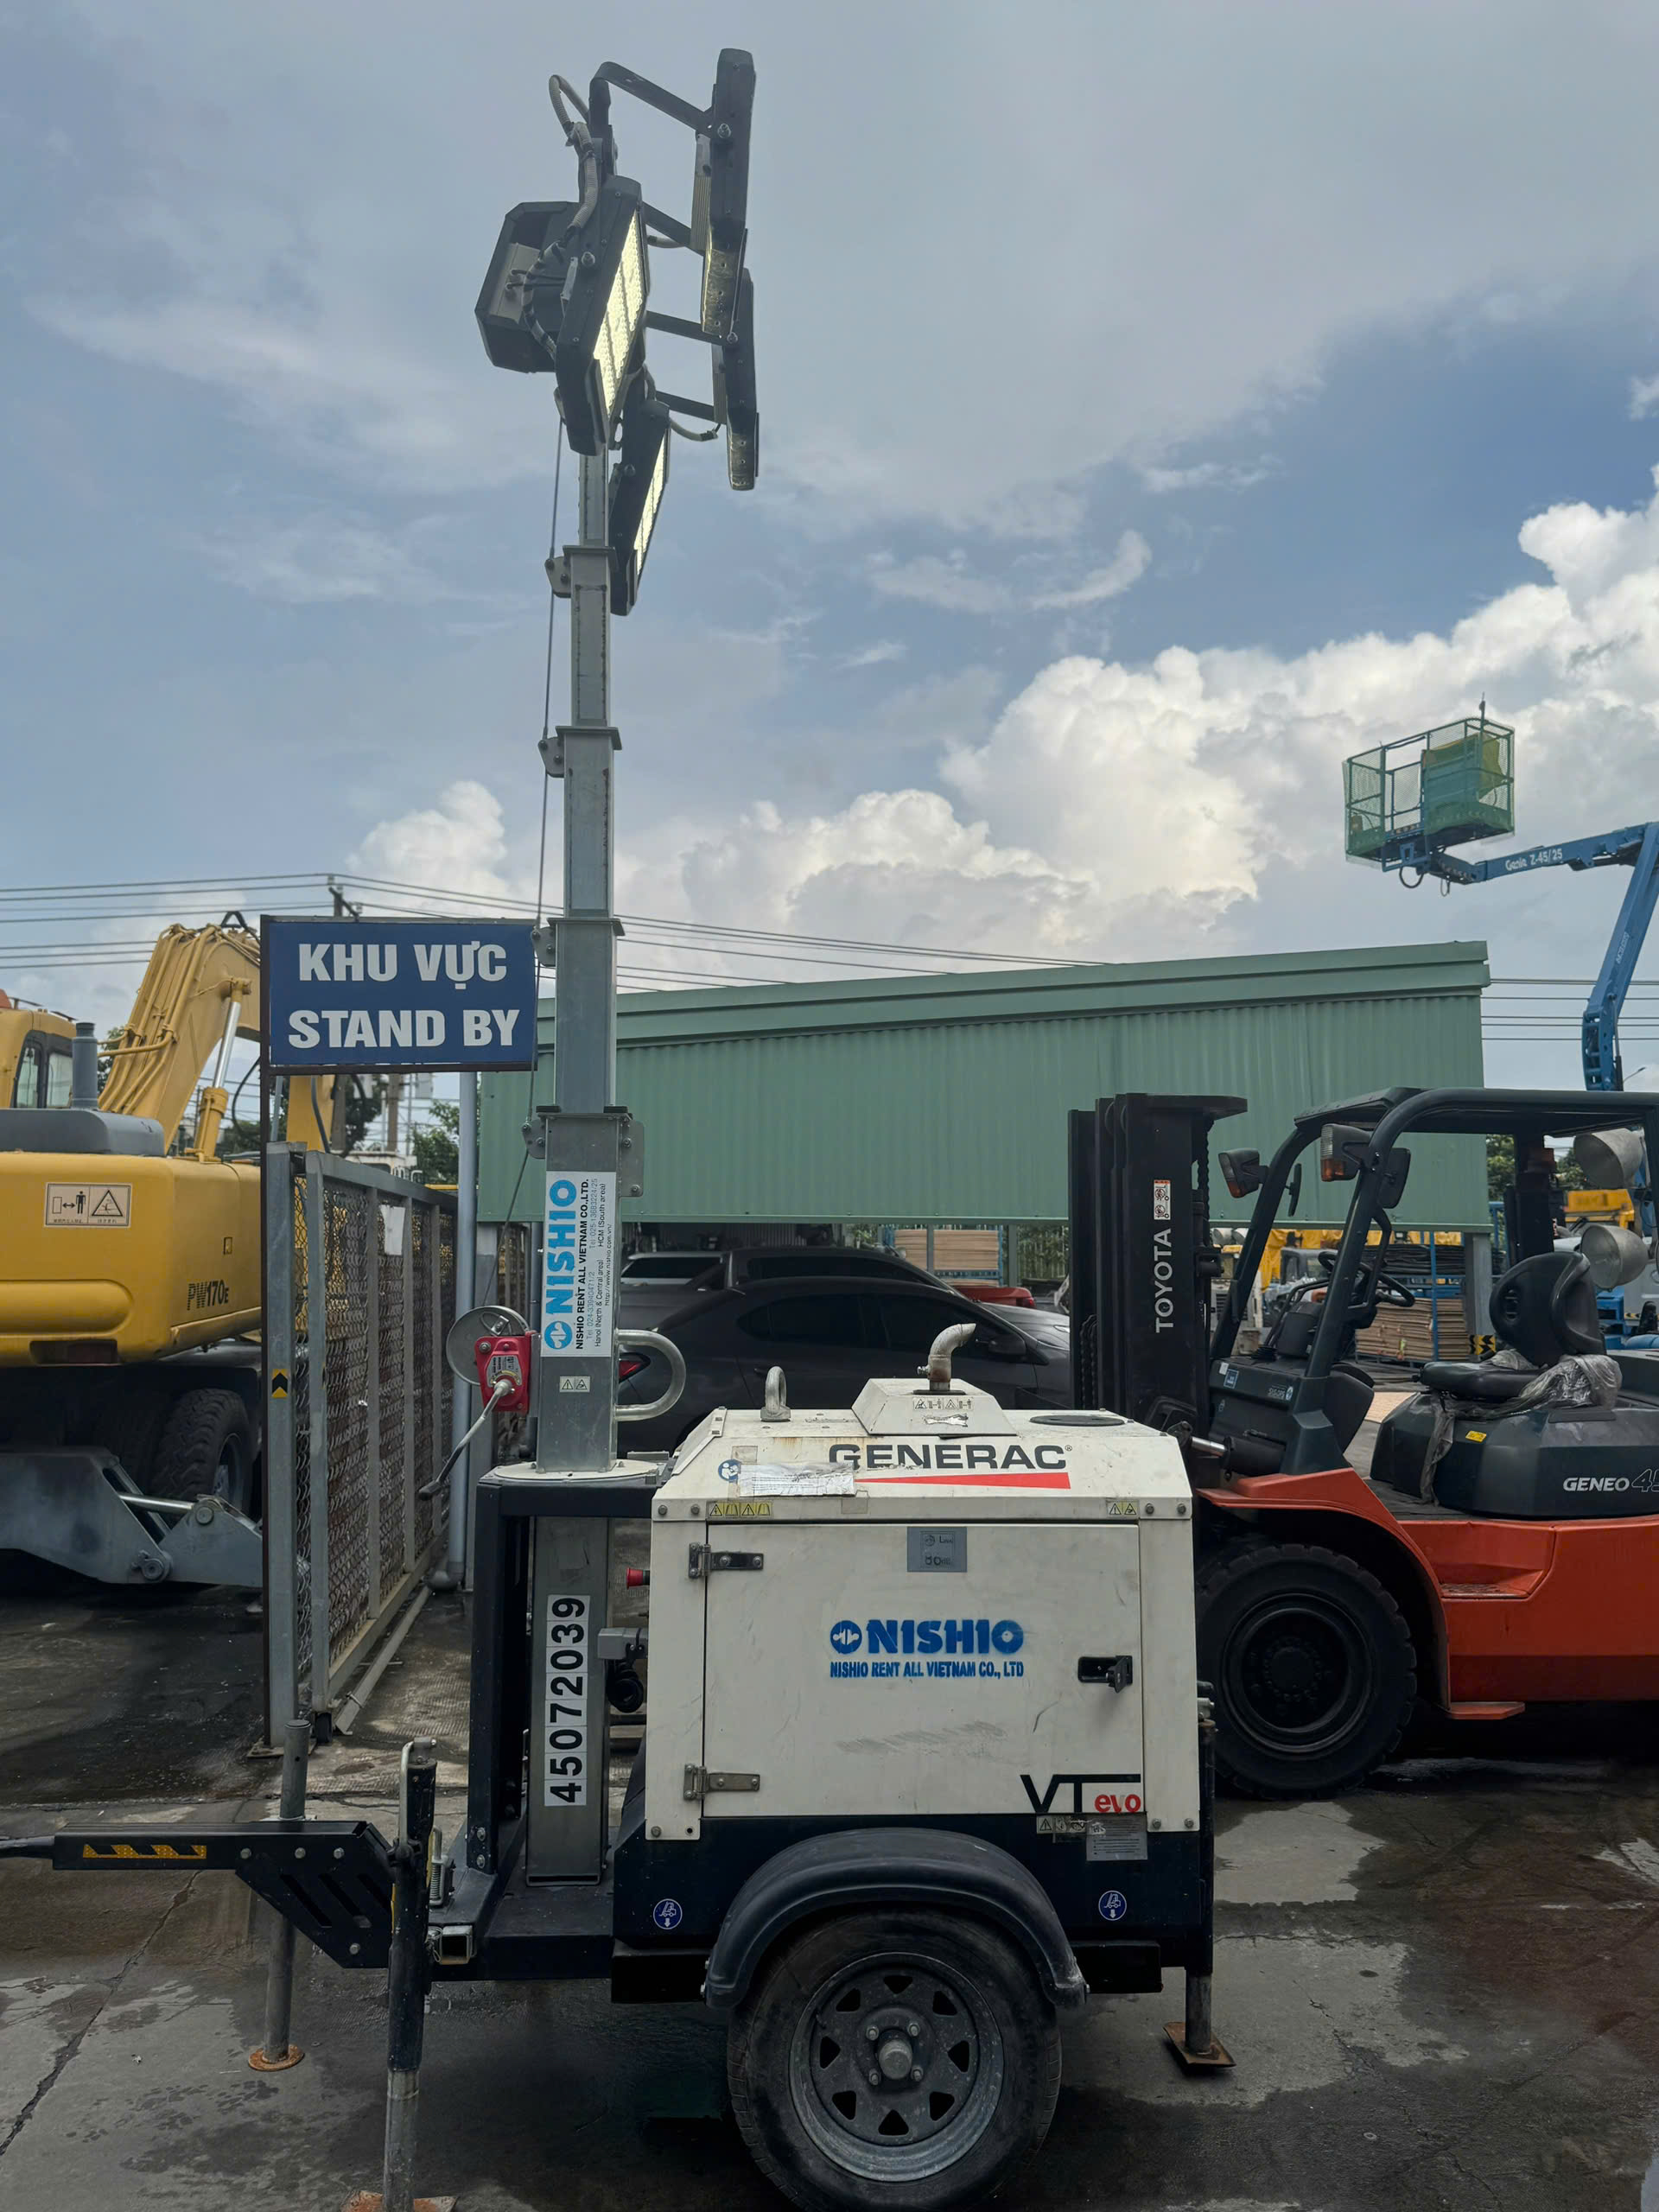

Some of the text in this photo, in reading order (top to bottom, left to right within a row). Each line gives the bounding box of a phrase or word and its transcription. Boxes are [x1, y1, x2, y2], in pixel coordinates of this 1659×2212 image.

[299, 940, 507, 989] KHU VỰC
[289, 1009, 520, 1048] STAND BY
[545, 1179, 577, 1314] NISHIO
[579, 1221, 588, 1264] VIETNAM
[1154, 1228, 1173, 1333] TOYOTA
[576, 1287, 585, 1313] RENT
[575, 1316, 585, 1350] NISHIO
[829, 1444, 1066, 1471] GENERAC
[1563, 1478, 1630, 1491] GENEO
[866, 1619, 1024, 1655] NISHIO
[830, 1661, 1024, 1679] NISHIO RENT ALL VIETNAM CO., LTD
[550, 1598, 585, 1803] 45072039
[1094, 1794, 1141, 1813] evo
